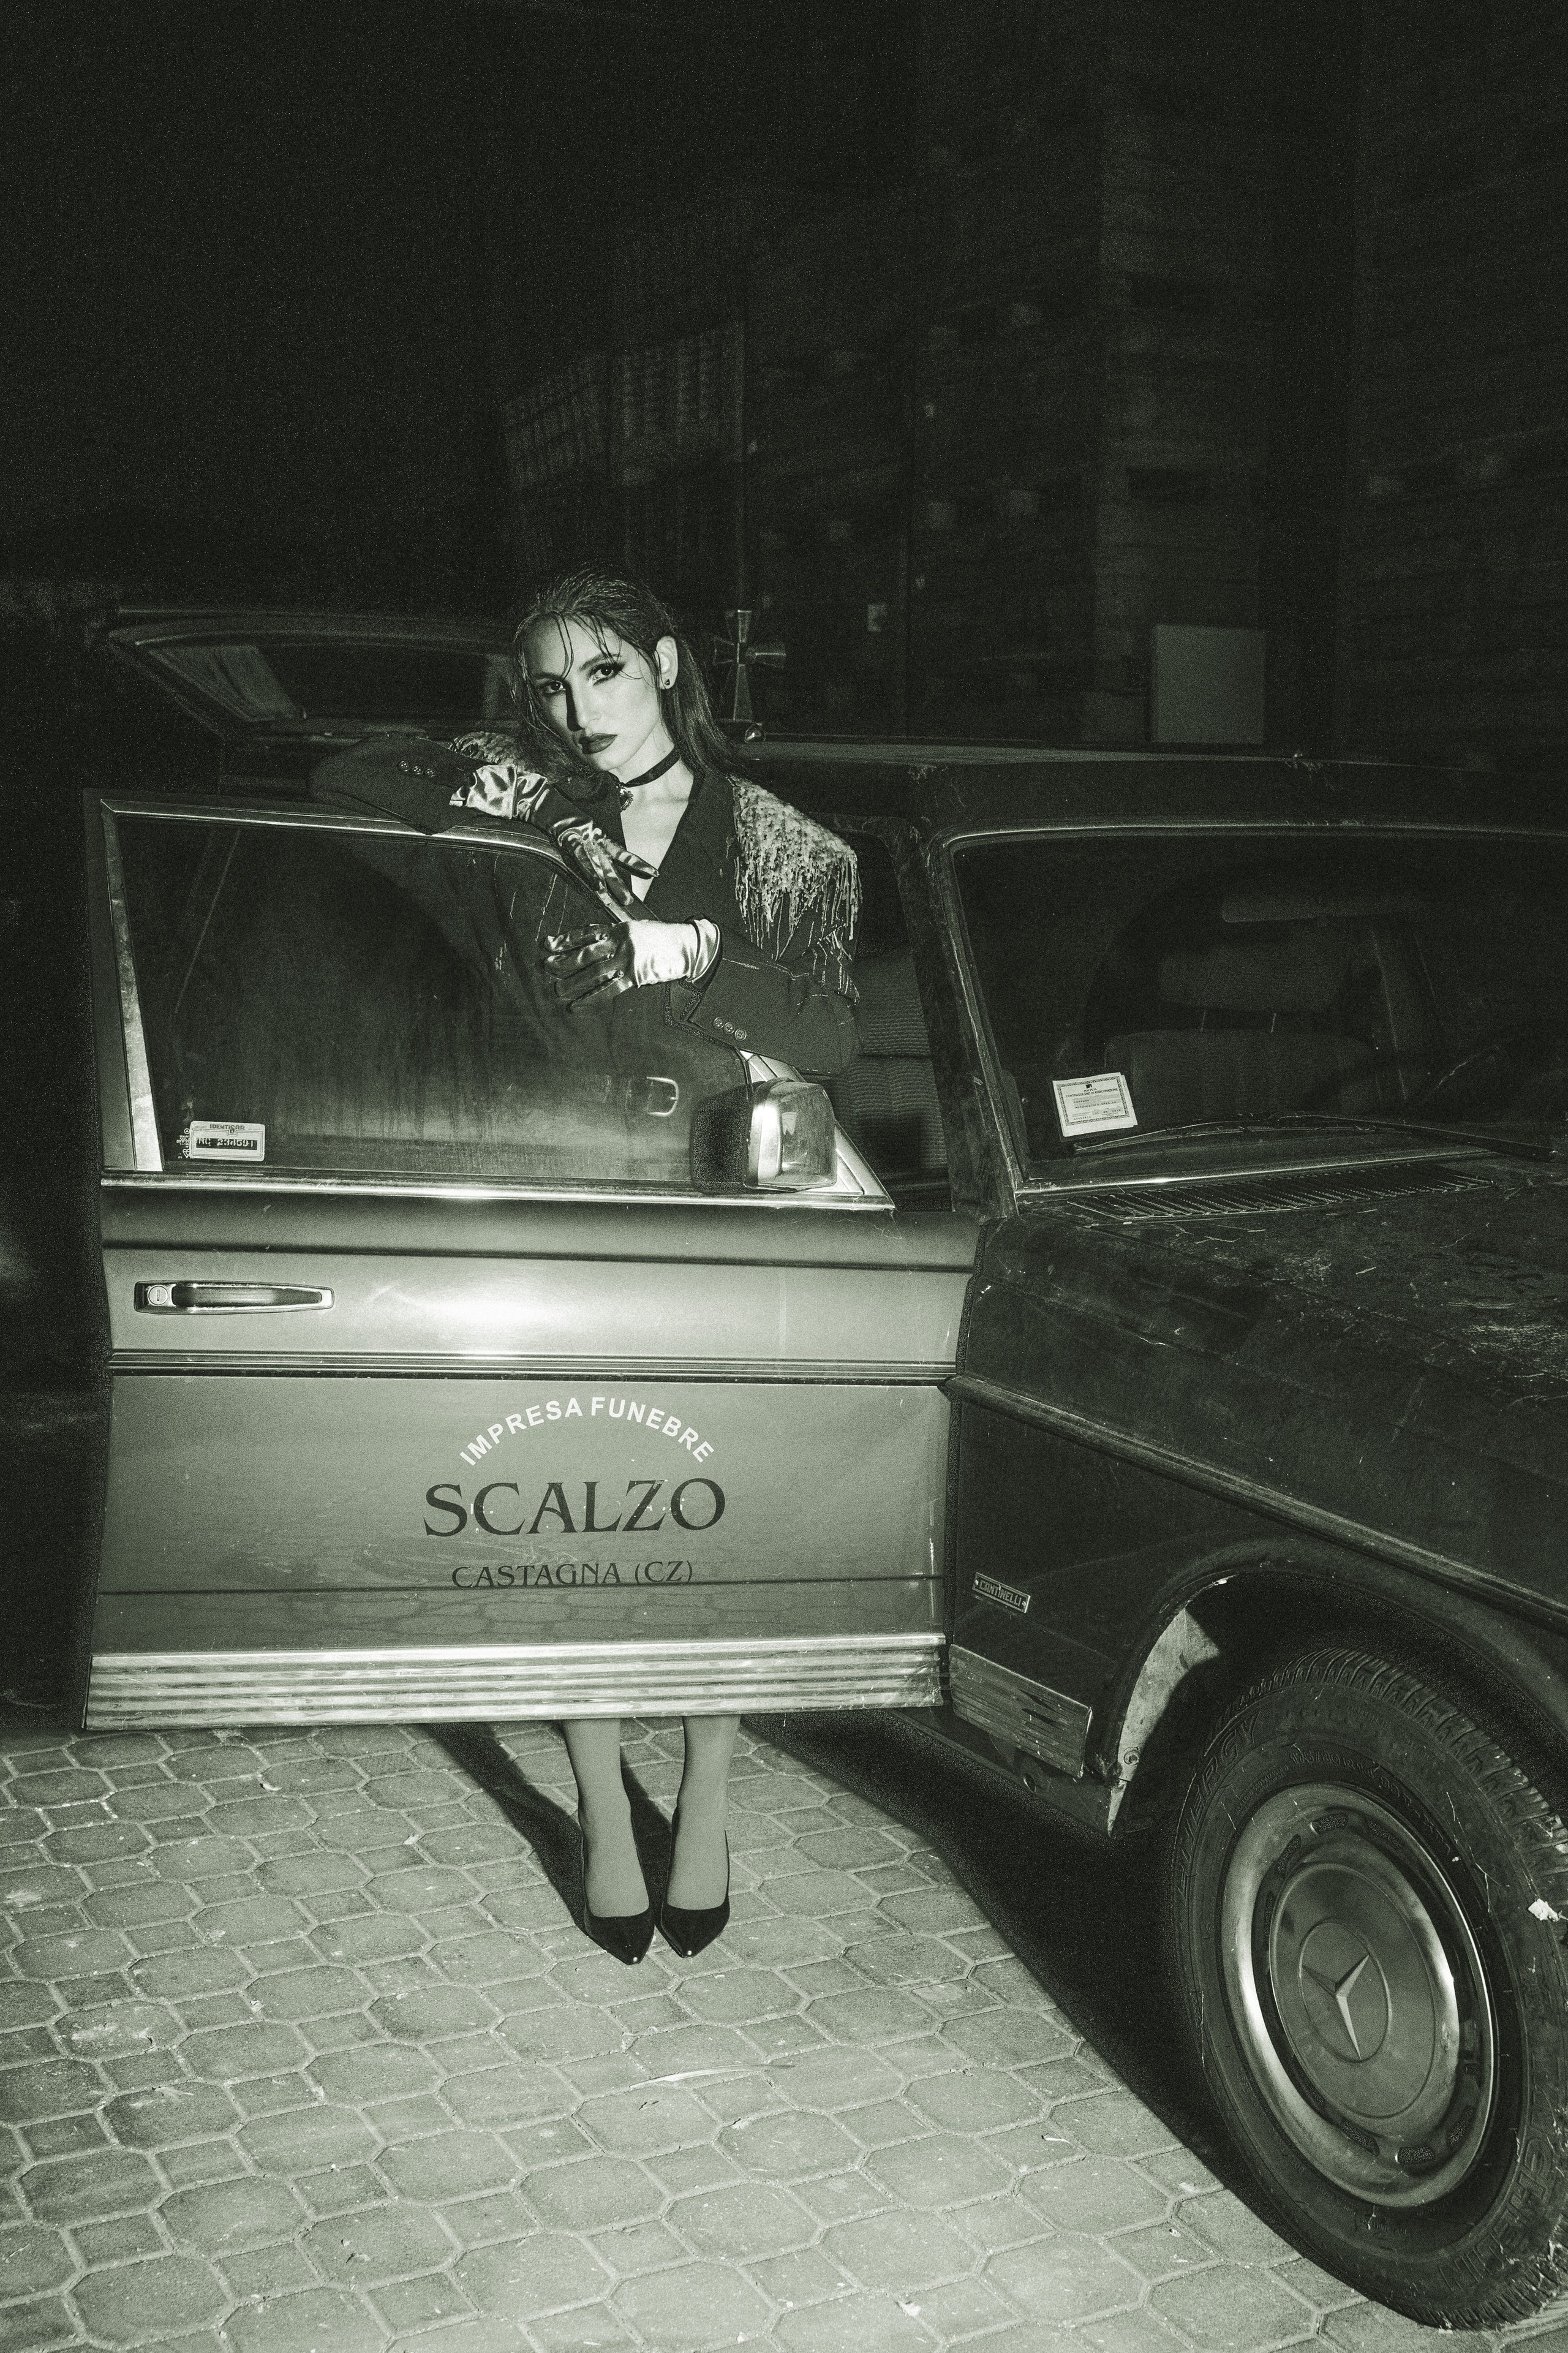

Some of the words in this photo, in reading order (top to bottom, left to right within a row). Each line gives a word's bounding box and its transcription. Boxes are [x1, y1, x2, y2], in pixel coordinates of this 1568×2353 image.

[459, 1397, 583, 1466] IMPRESA
[592, 1397, 714, 1462] FUNEBRE
[423, 1478, 726, 1537] SCALZO
[452, 1563, 621, 1588] CASTAGNA
[635, 1560, 693, 1584] (CZ)
